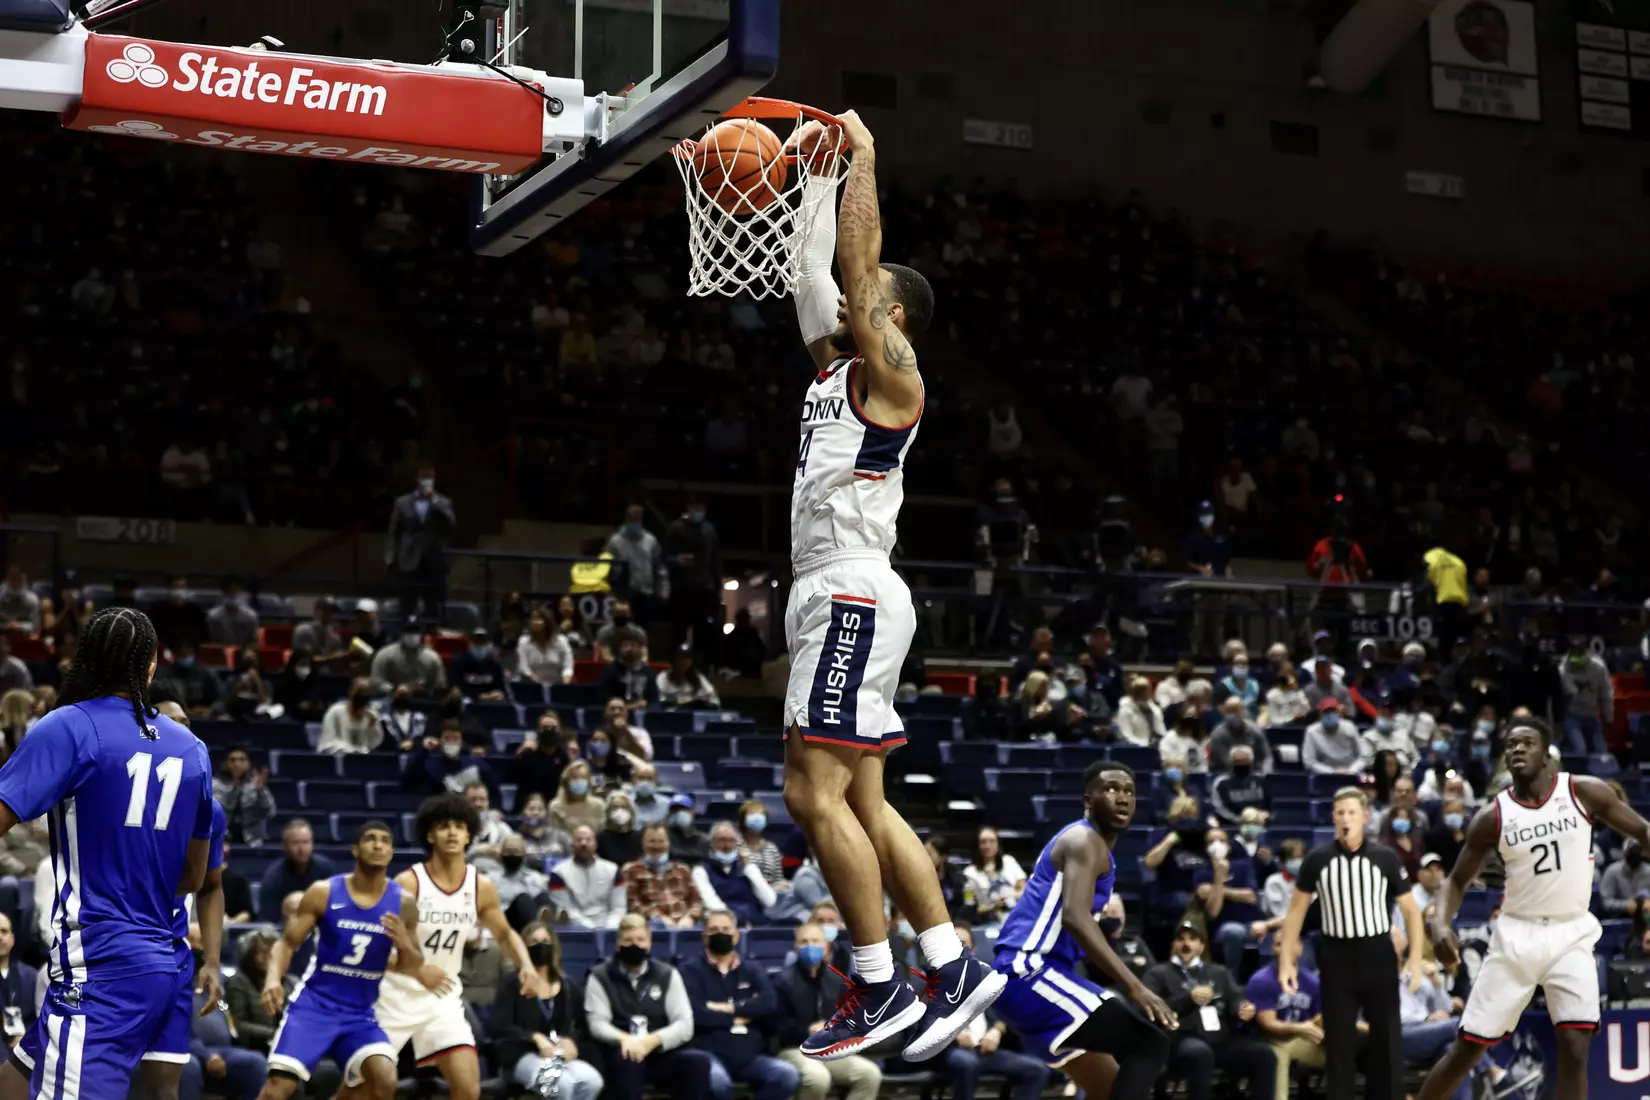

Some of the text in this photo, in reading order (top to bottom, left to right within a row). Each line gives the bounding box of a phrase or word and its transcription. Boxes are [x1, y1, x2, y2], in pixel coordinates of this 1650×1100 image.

[1385, 615, 1434, 641] 109
[823, 612, 860, 724] HUSKIES
[124, 751, 183, 831] 11
[1504, 816, 1577, 847] UCONN
[1530, 840, 1562, 876] 21
[418, 911, 473, 925] UCONN
[341, 933, 372, 966] 3
[424, 929, 460, 955] 44
[1607, 1021, 1650, 1084] U
